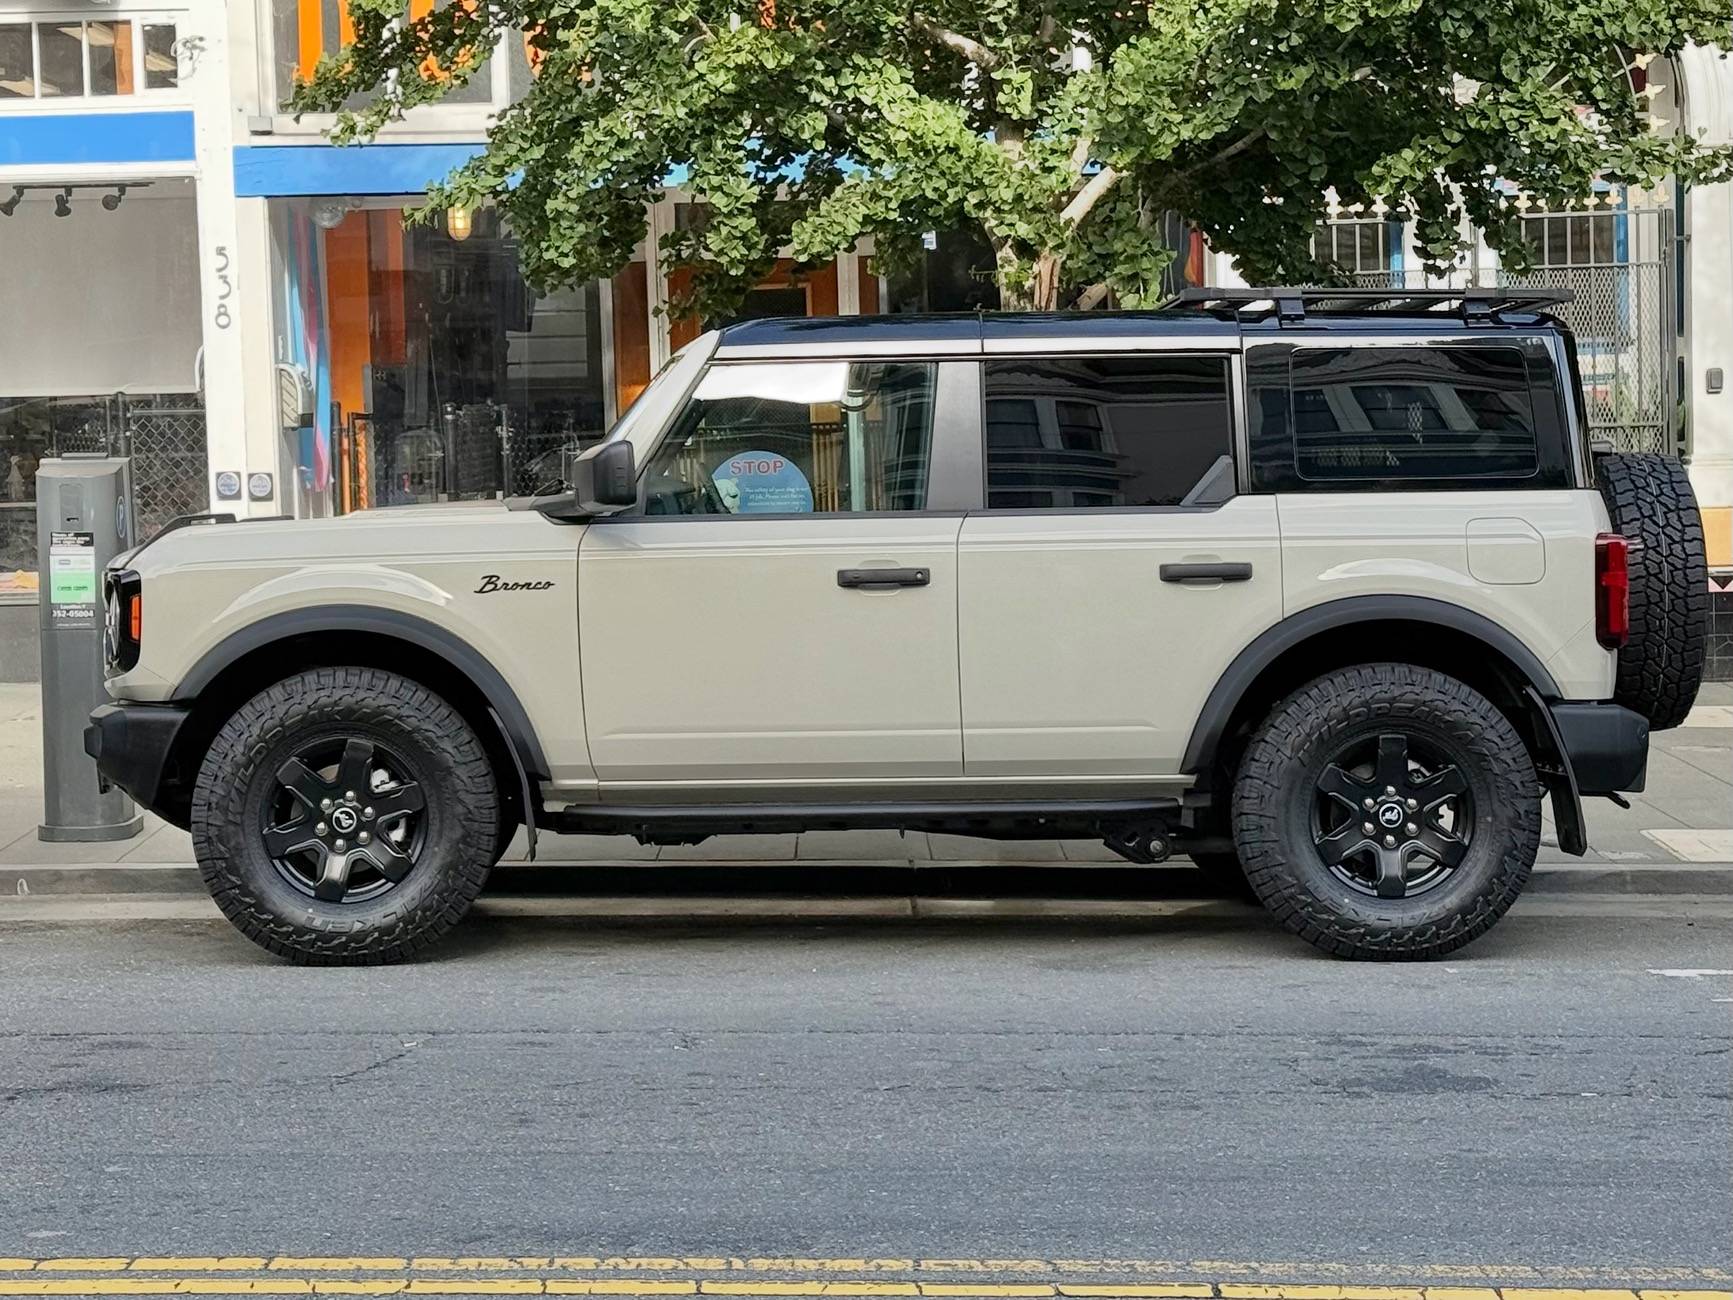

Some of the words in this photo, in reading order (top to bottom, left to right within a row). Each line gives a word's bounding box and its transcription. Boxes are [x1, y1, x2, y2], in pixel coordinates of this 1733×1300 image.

[215, 246, 231, 329] 538
[730, 460, 784, 475] STOP
[474, 575, 555, 594] Bronco
